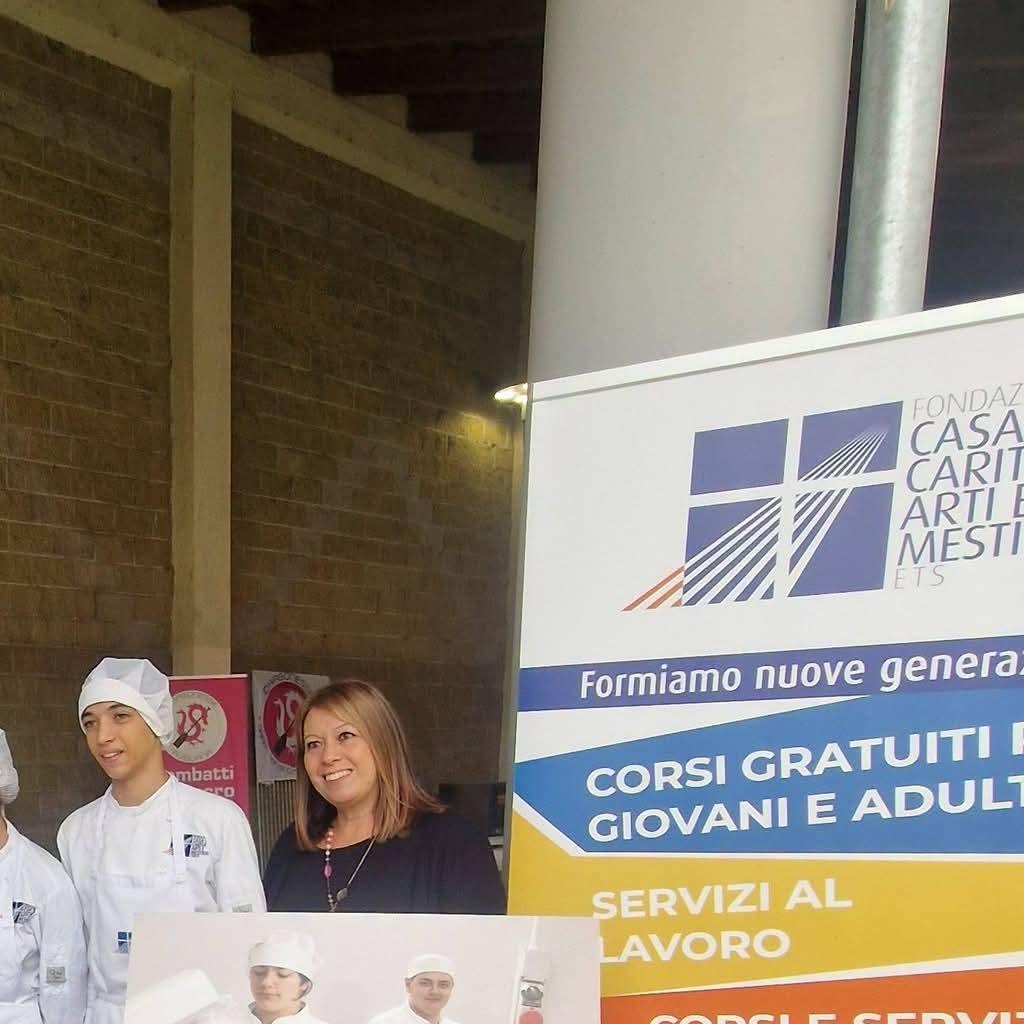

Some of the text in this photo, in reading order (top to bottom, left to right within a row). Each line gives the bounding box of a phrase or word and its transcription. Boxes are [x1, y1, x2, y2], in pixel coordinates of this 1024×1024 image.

[913, 383, 1024, 420] FONDAZ
[910, 409, 1024, 457] CASA
[906, 446, 1024, 493] CARIT
[900, 487, 995, 530] ARTI
[897, 521, 1022, 566] MESTI
[894, 564, 945, 591] ETS
[580, 663, 742, 699] Formiamo
[755, 659, 866, 690] nuove
[175, 765, 234, 782] mbatti
[585, 755, 726, 798] CORSI
[741, 725, 990, 783] GRATUITI
[587, 797, 788, 843] GIOVANI
[808, 792, 836, 826] E
[592, 878, 853, 920] SERVIZI AL
[600, 928, 791, 964] LAVORO
